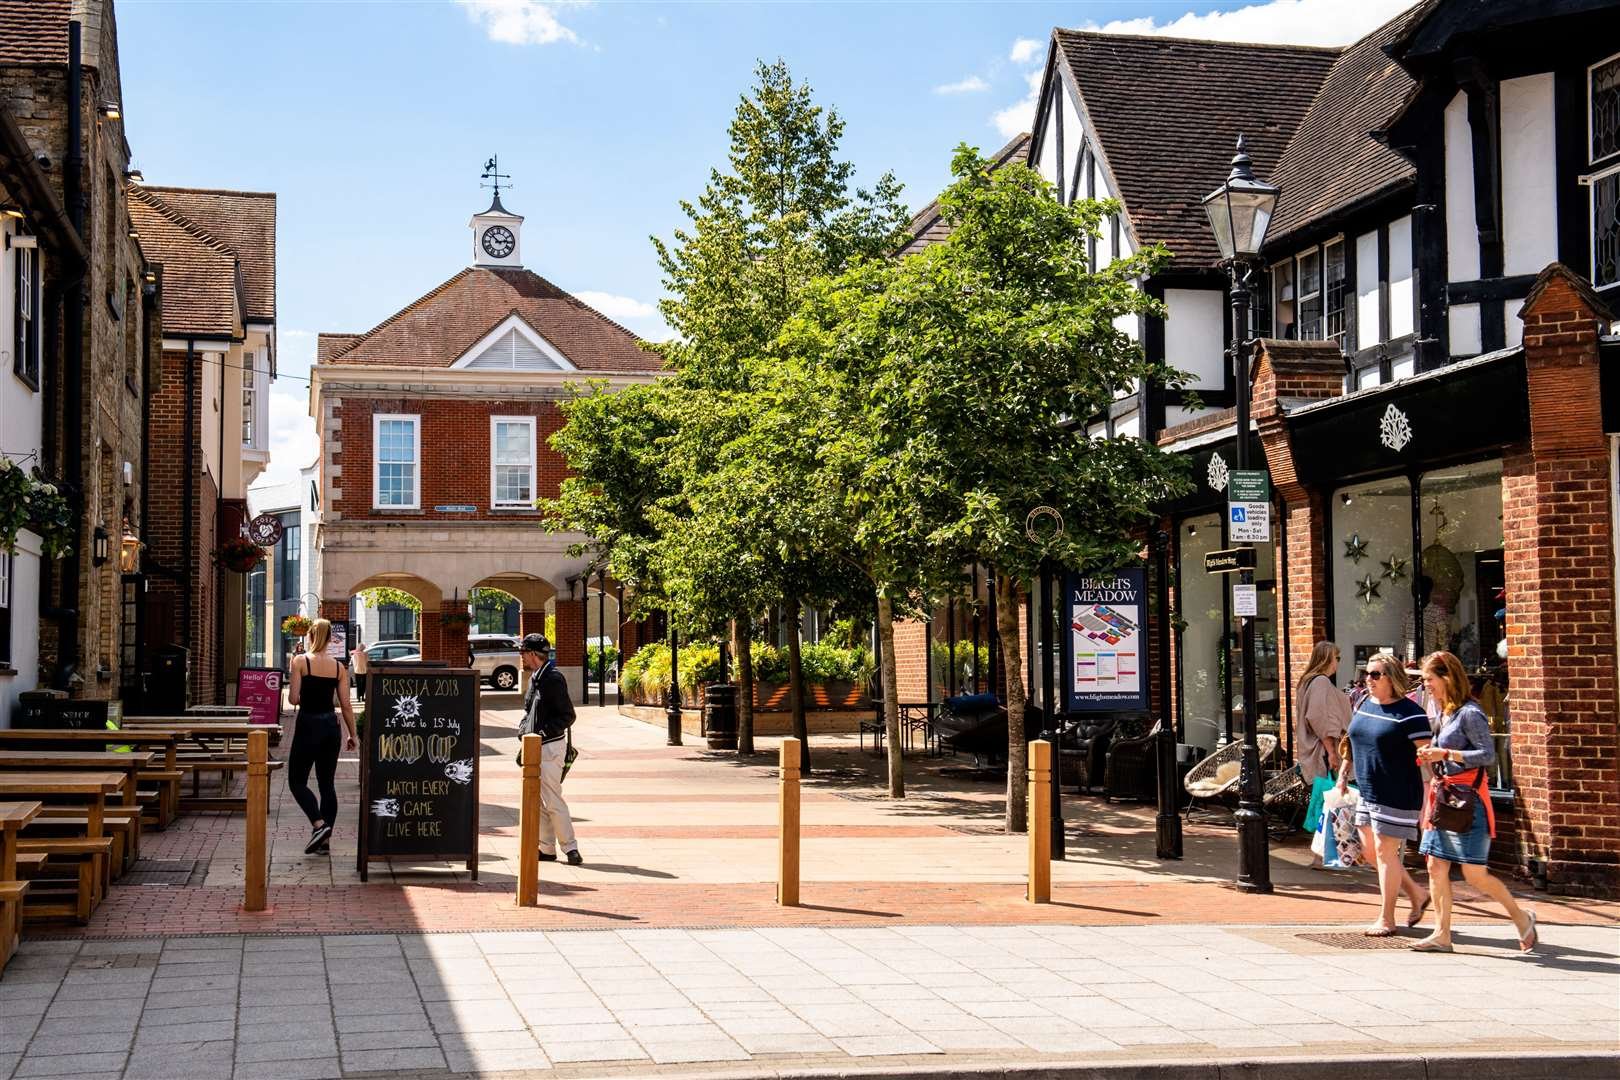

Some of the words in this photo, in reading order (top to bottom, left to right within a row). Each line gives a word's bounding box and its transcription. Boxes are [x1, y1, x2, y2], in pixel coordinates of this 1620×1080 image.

[256, 514, 277, 526] COSTA
[1080, 578, 1131, 590] BLIGH'S
[1074, 591, 1136, 602] MEADOW
[382, 678, 430, 696] RUSSIA
[435, 678, 460, 696] 2018
[446, 718, 460, 736] July
[378, 733, 424, 764] WORLD
[427, 734, 457, 763] CUP
[386, 780, 417, 796] WATCH
[422, 780, 450, 796] EVERY
[403, 800, 434, 816] GAME
[387, 822, 412, 837] LIVE
[418, 820, 442, 837] HERE
